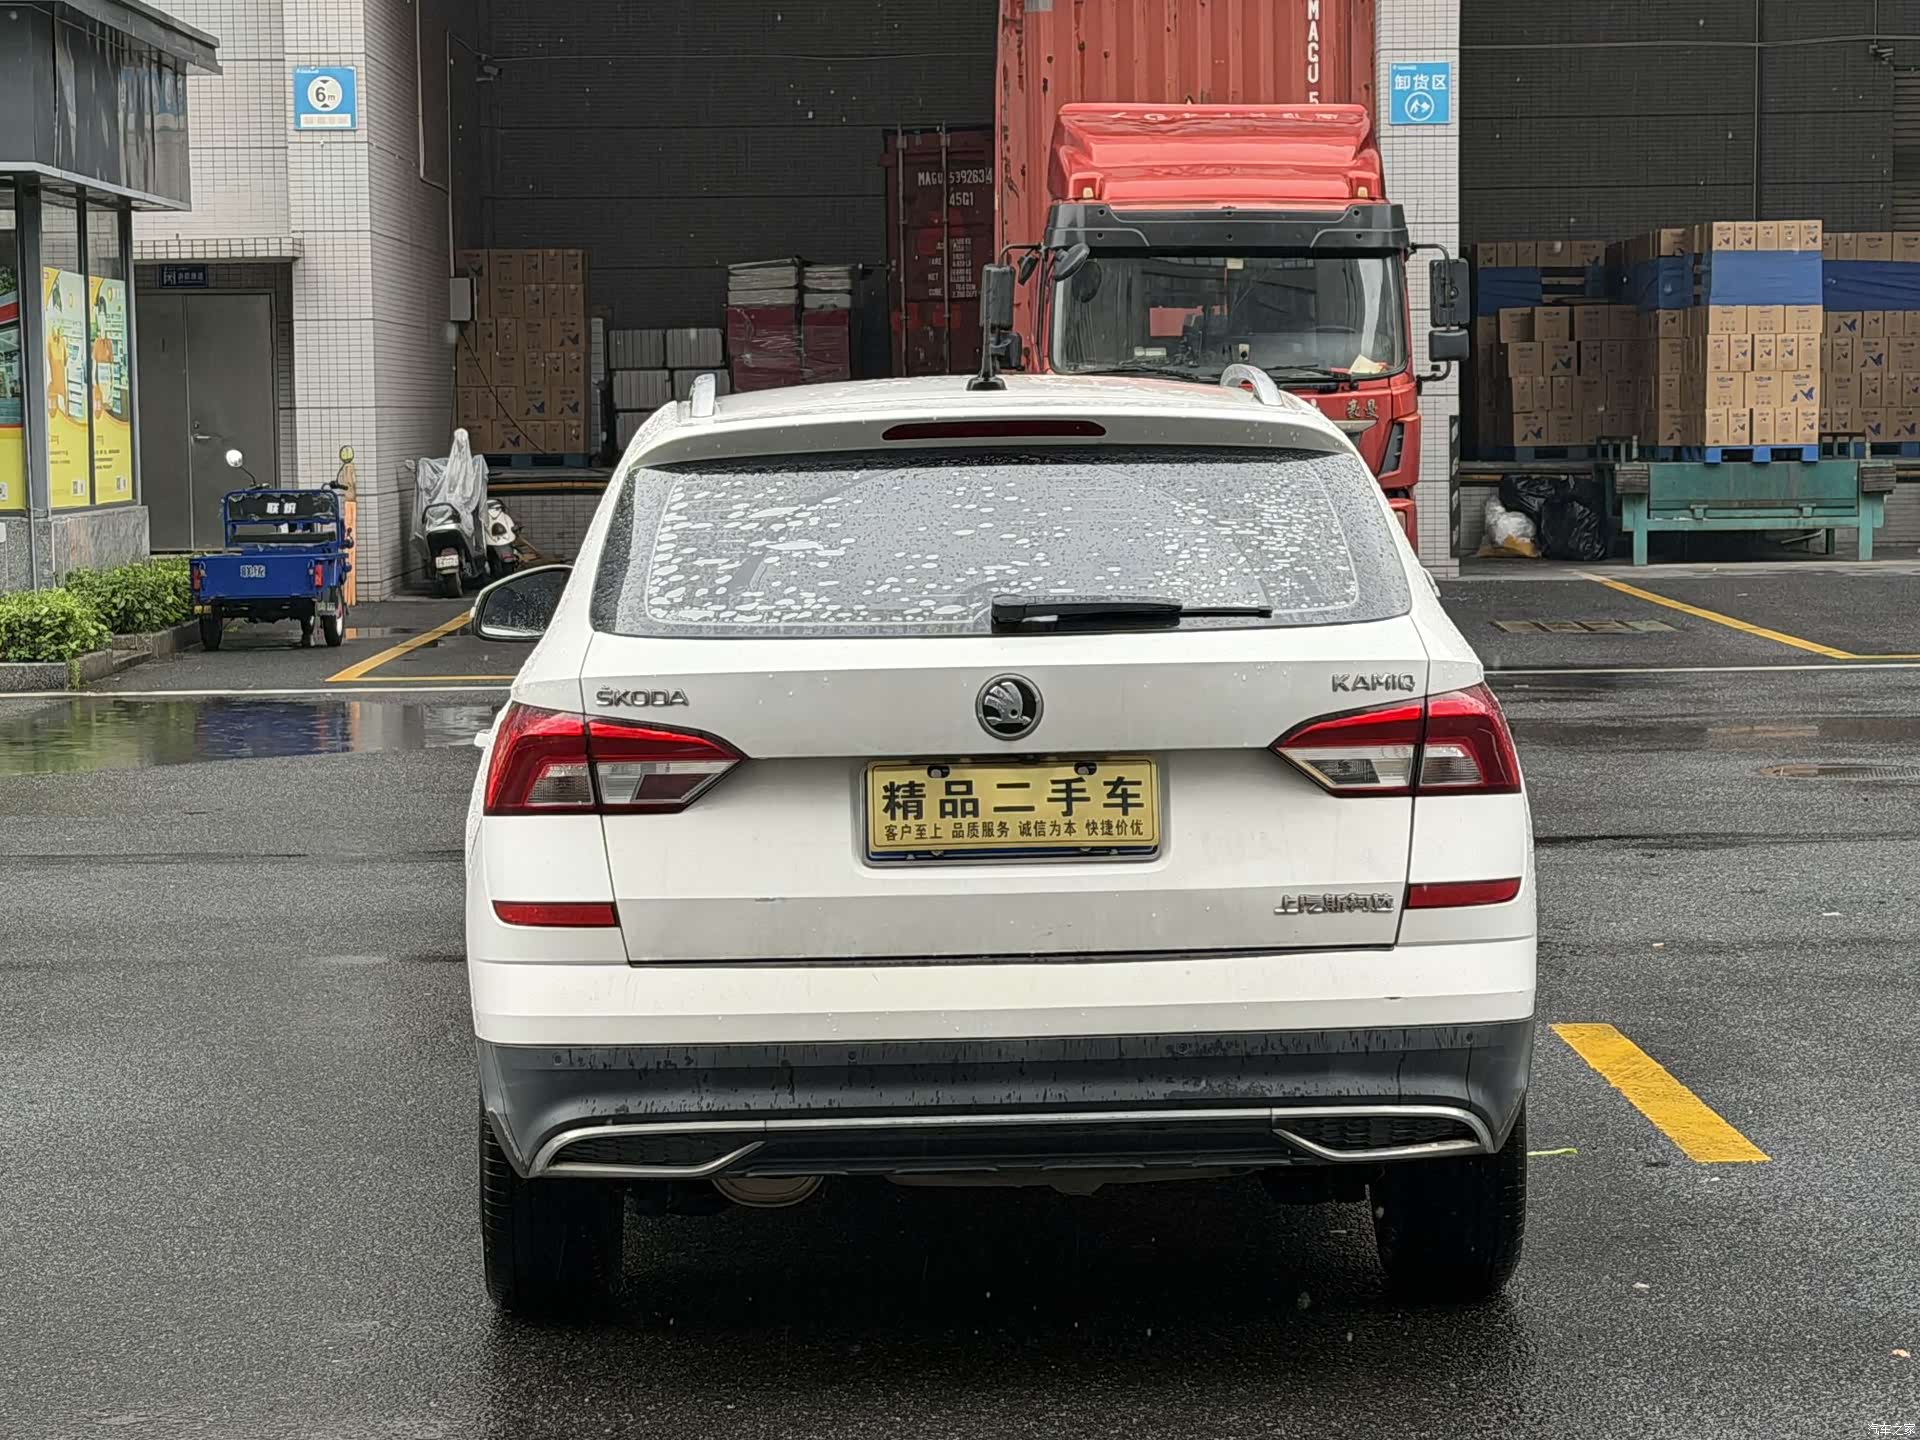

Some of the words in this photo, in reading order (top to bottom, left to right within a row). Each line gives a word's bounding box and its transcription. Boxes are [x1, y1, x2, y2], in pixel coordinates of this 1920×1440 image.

[1307, 0, 1319, 83] MAGU
[1394, 73, 1448, 91] 卸货区
[917, 171, 943, 185] MAGU
[949, 192, 974, 206] 45G1
[1331, 673, 1415, 692] KAMIQ
[882, 776, 1144, 821] 精品二手车
[884, 823, 943, 841] 客户至上
[952, 821, 1010, 839] 品质服务
[1018, 820, 1077, 837] 诚信为本
[1085, 819, 1143, 836] 快捷价优
